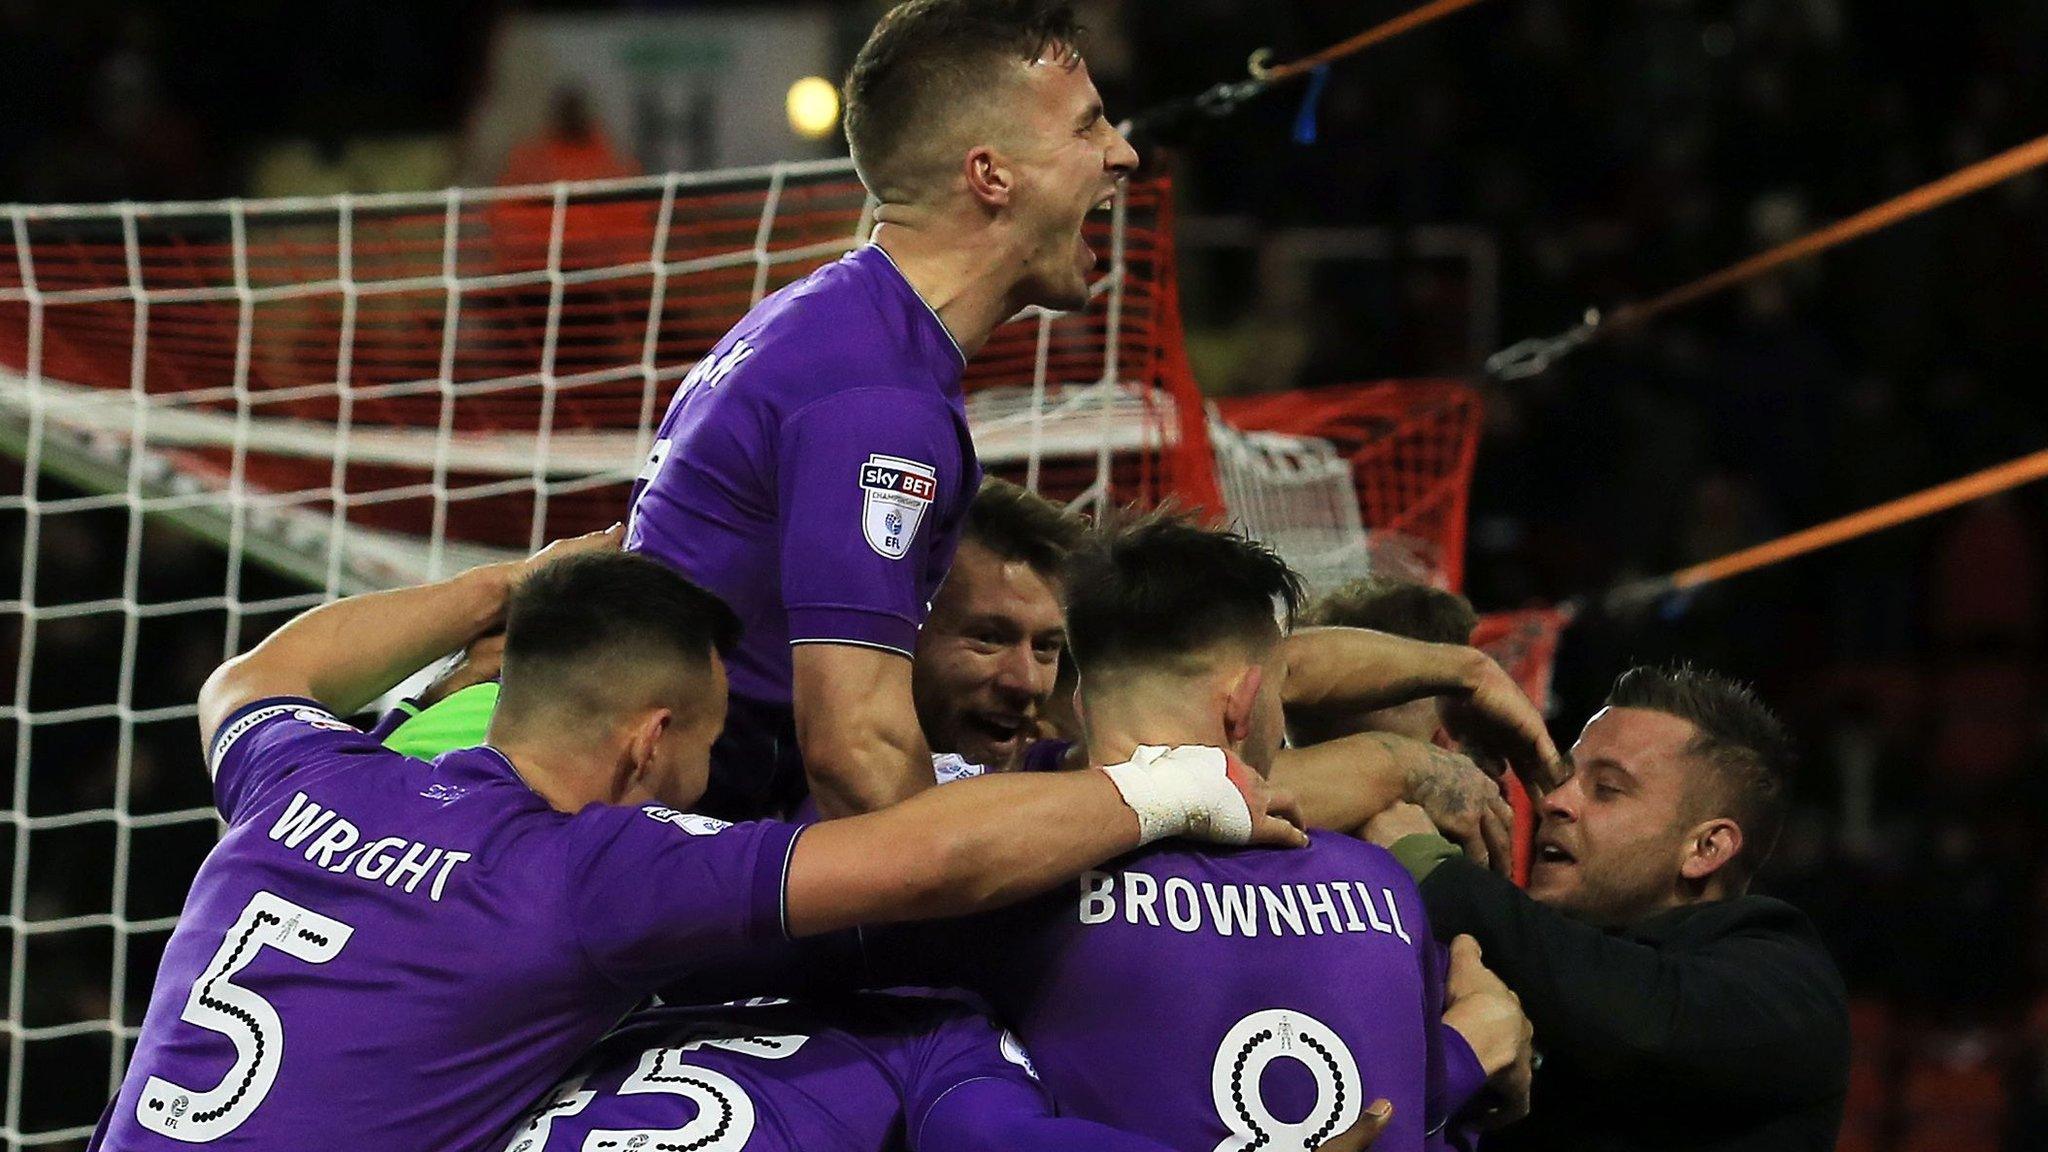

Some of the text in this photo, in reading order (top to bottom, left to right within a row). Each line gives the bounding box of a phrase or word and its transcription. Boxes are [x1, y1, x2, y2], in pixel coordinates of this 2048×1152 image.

[866, 468, 932, 497] sky BET
[885, 536, 901, 550] EFL
[219, 708, 287, 753] CAPTAIN
[268, 791, 472, 902] WRIGHT
[1079, 871, 1411, 945] BROWNHILL
[136, 890, 356, 1143] 5
[1211, 1008, 1364, 1152] 8
[164, 1116, 178, 1130] EFL
